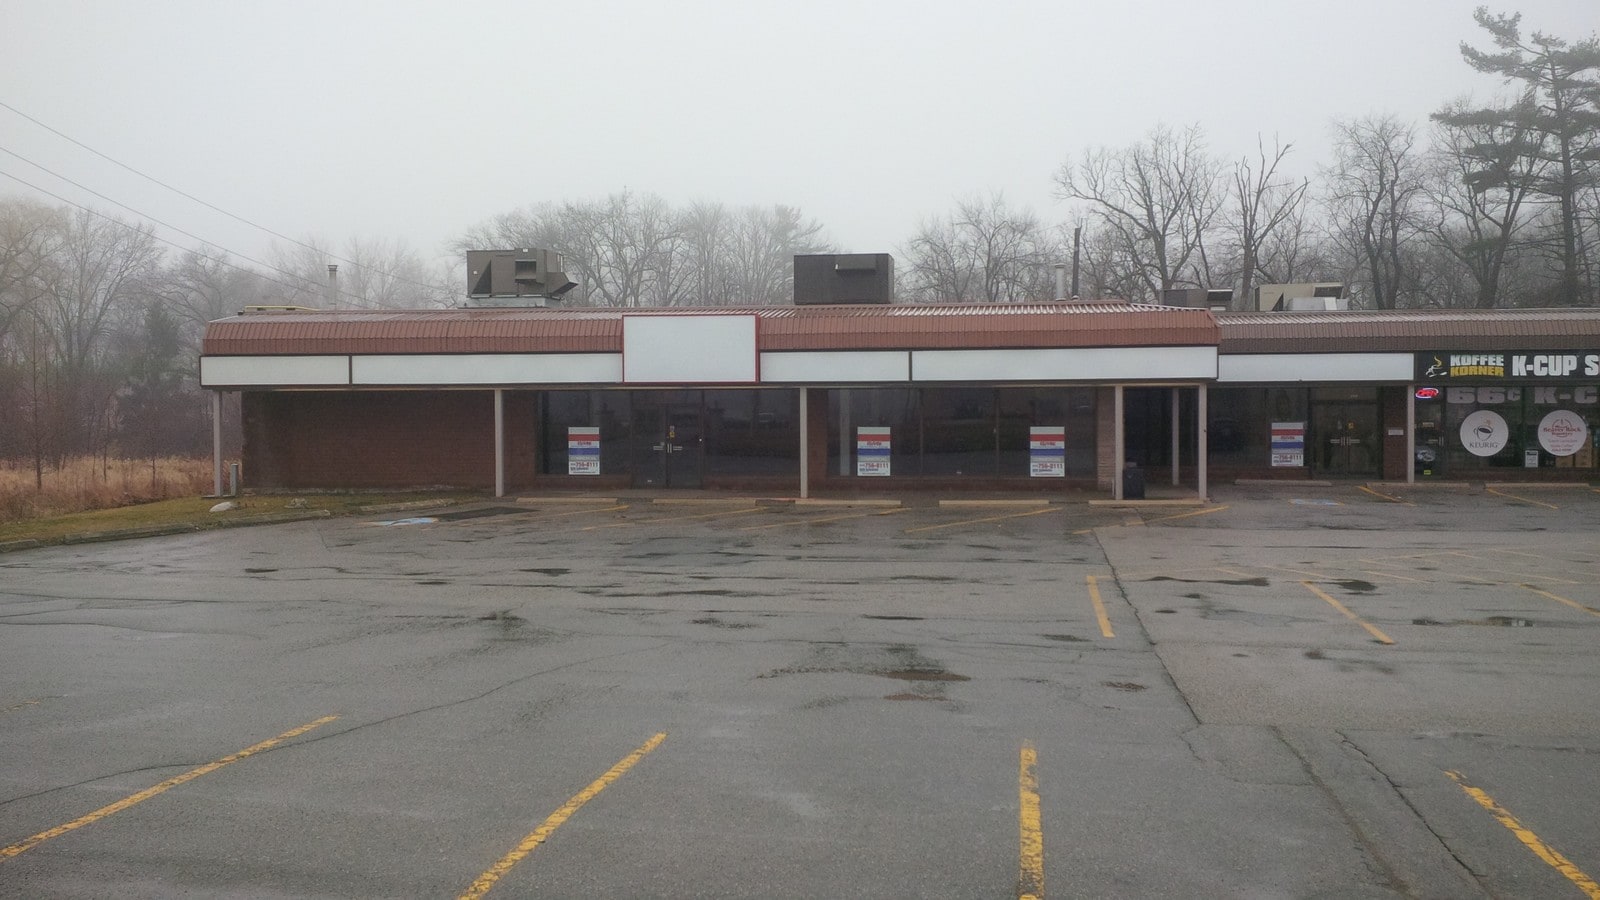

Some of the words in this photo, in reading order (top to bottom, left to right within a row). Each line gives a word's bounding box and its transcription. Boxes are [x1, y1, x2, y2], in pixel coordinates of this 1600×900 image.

[1450, 354, 1504, 366] KOFFEE
[1512, 355, 1577, 376] K-CUP
[1584, 354, 1600, 376] S
[1450, 366, 1504, 377] KORNER
[1469, 441, 1498, 449] KEURIG
